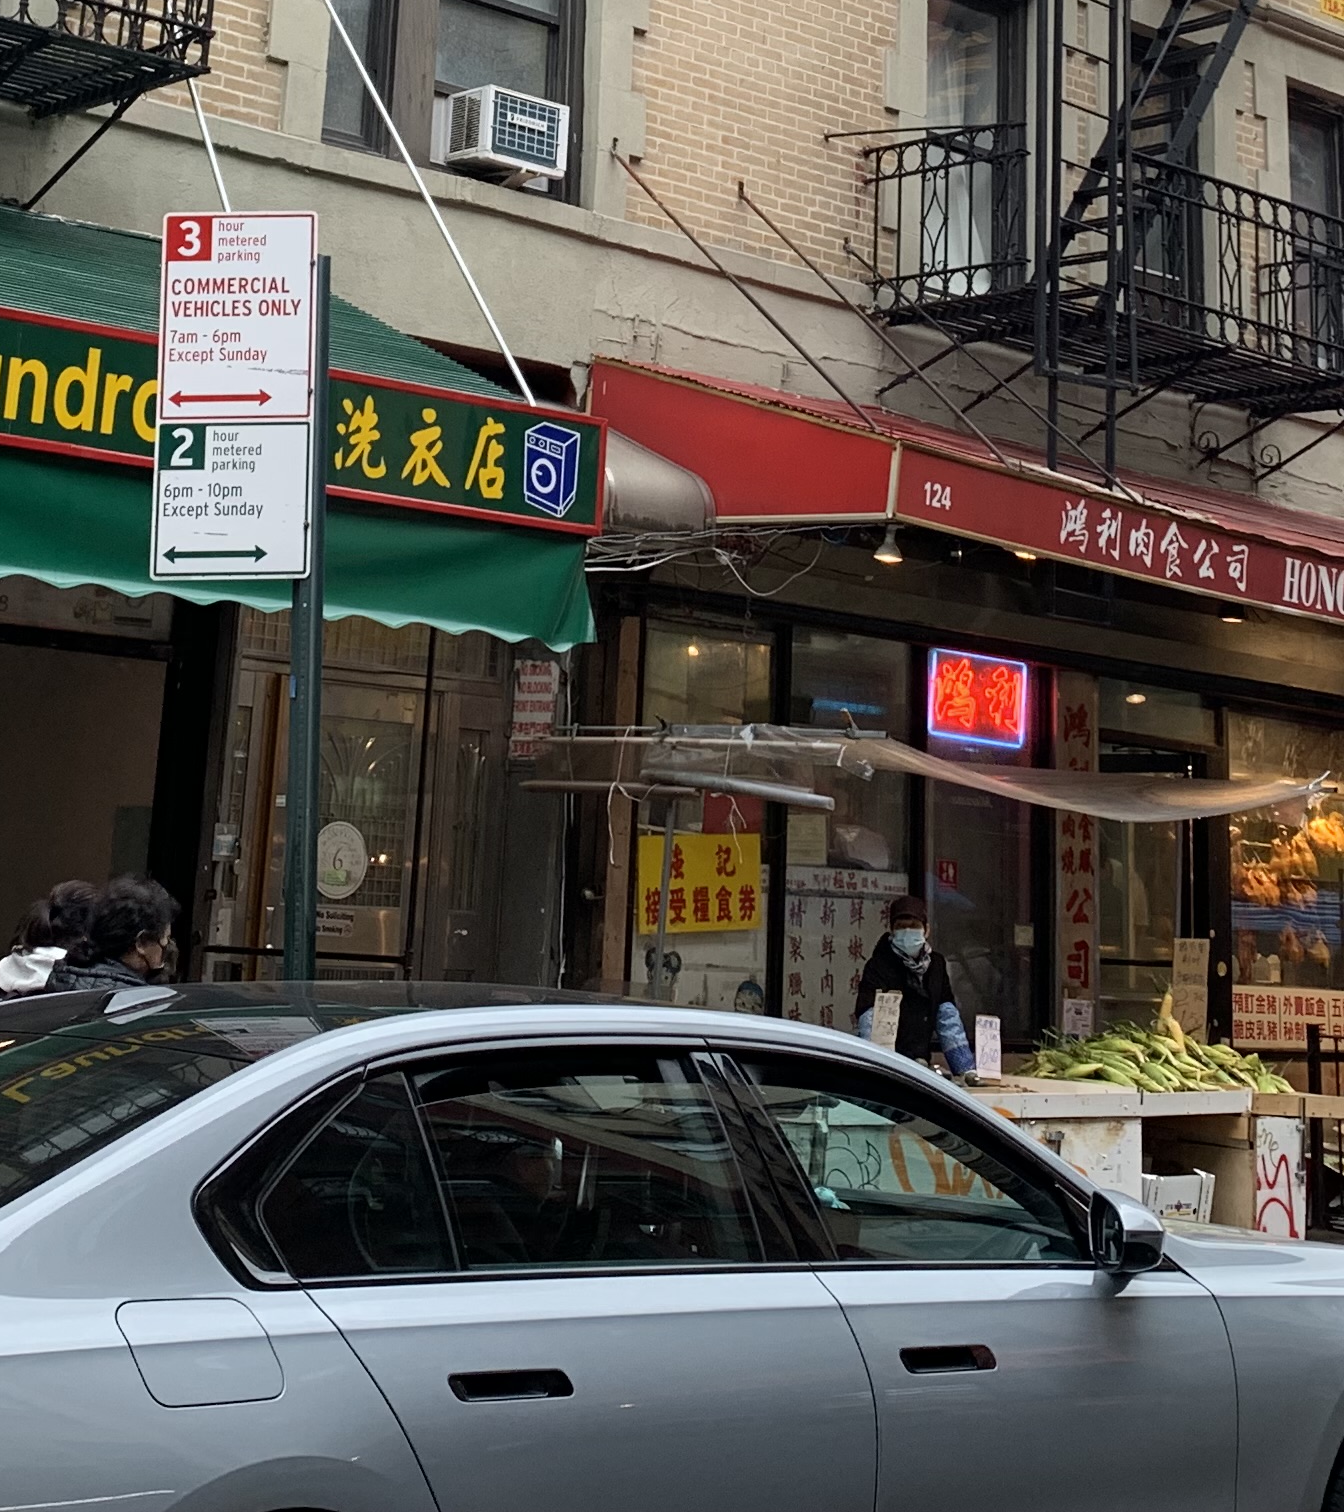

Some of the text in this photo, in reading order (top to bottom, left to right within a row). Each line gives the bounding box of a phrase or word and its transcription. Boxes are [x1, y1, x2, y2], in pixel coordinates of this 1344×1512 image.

[218, 220, 245, 233] hour
[176, 220, 202, 257] 3
[218, 234, 267, 247] metered
[217, 249, 262, 264] parking
[171, 277, 290, 297] COMMERCIAL
[171, 299, 302, 318] VEHICLES ONLY
[170, 329, 198, 344] 7am
[211, 329, 242, 347] 6pm
[168, 347, 267, 366] Except Sunday
[212, 429, 239, 443] hour
[169, 427, 195, 467] 2
[212, 444, 262, 457] metered
[334, 394, 507, 501] 洗衣店
[211, 458, 256, 473] parking
[163, 483, 195, 501] 6pm
[207, 483, 243, 501] 10pm
[923, 481, 952, 512] 124
[162, 500, 263, 520] Except Sunday
[1059, 501, 1249, 593] 鴻利肉食公司
[645, 884, 756, 926] 接受糧食券
[325, 910, 354, 922] Soliciting
